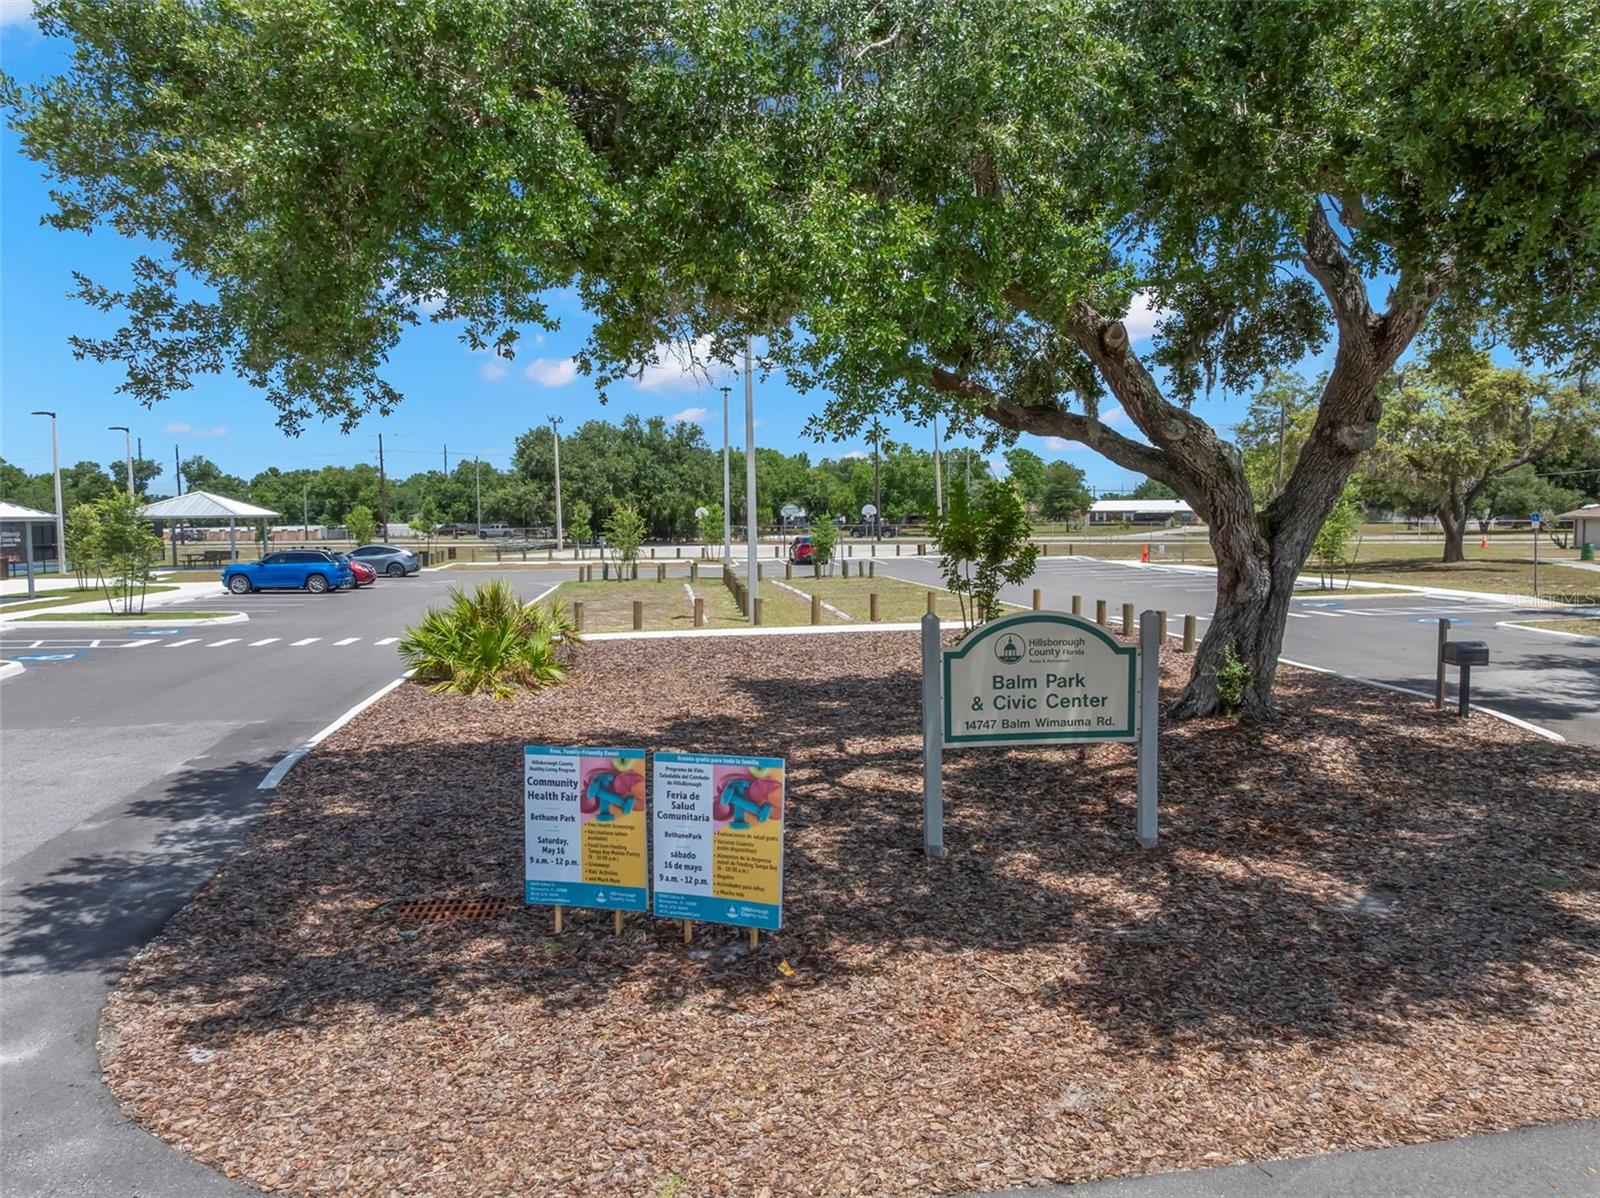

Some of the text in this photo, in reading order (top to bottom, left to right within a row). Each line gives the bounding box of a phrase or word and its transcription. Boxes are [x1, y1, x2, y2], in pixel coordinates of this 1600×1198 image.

[1028, 637, 1086, 648] Hillsborough
[1028, 648, 1060, 658] County
[992, 673, 1086, 690] Balm Park
[971, 693, 1108, 711] & Civic Center
[964, 716, 1116, 730] 14747 Balm Wimauma Rd.
[527, 777, 578, 790] Community
[528, 790, 578, 802] Health Fair
[666, 790, 700, 800] Feria de
[671, 801, 696, 811] Salud
[530, 813, 576, 822] Bethune Park
[656, 811, 710, 822] Comunitaria
[664, 831, 703, 840] BethunePark
[537, 836, 569, 847] Saturday,
[542, 846, 565, 856] May 16
[530, 856, 535, 864] 9
[555, 857, 564, 865] 12
[564, 859, 580, 867] p.m.
[664, 861, 703, 873] 16 de mayo
[659, 873, 665, 882] 9
[665, 875, 680, 883] a.m.
[685, 876, 693, 884] 12
[694, 878, 709, 886] p.m.
